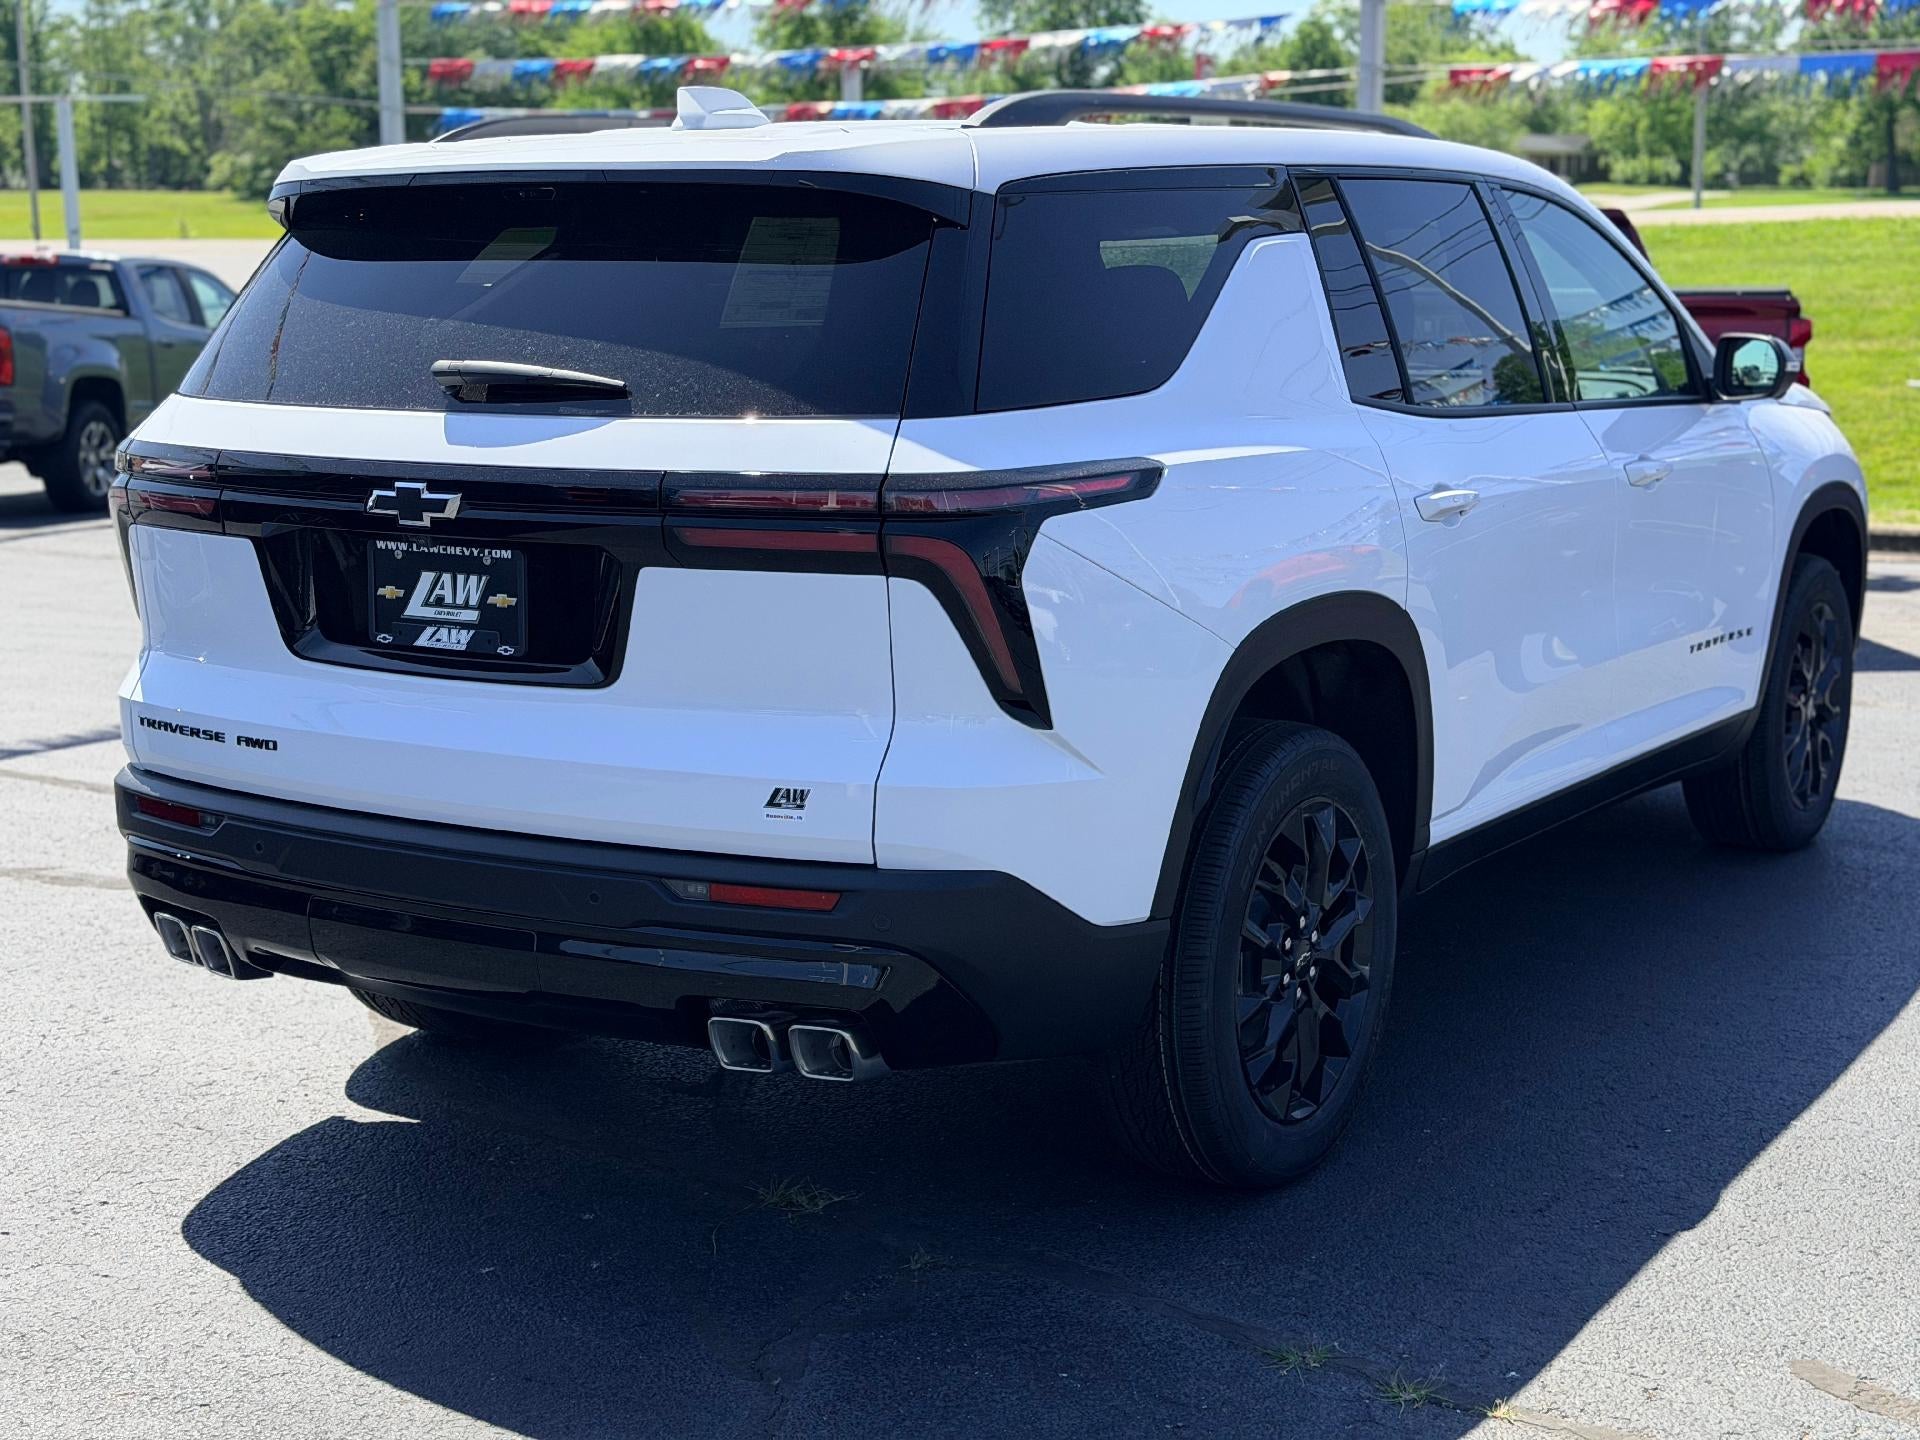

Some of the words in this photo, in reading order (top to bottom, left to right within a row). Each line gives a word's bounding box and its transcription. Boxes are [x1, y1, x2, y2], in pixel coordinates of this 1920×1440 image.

[376, 540, 512, 559] WWW.LAWCHEVY.COM
[401, 571, 489, 624] LAW
[413, 626, 476, 650] LAW
[1689, 626, 1753, 654] TRAVERSE
[138, 715, 226, 743] TRAVERSE
[237, 735, 278, 751] AWD
[763, 787, 811, 810] LAW
